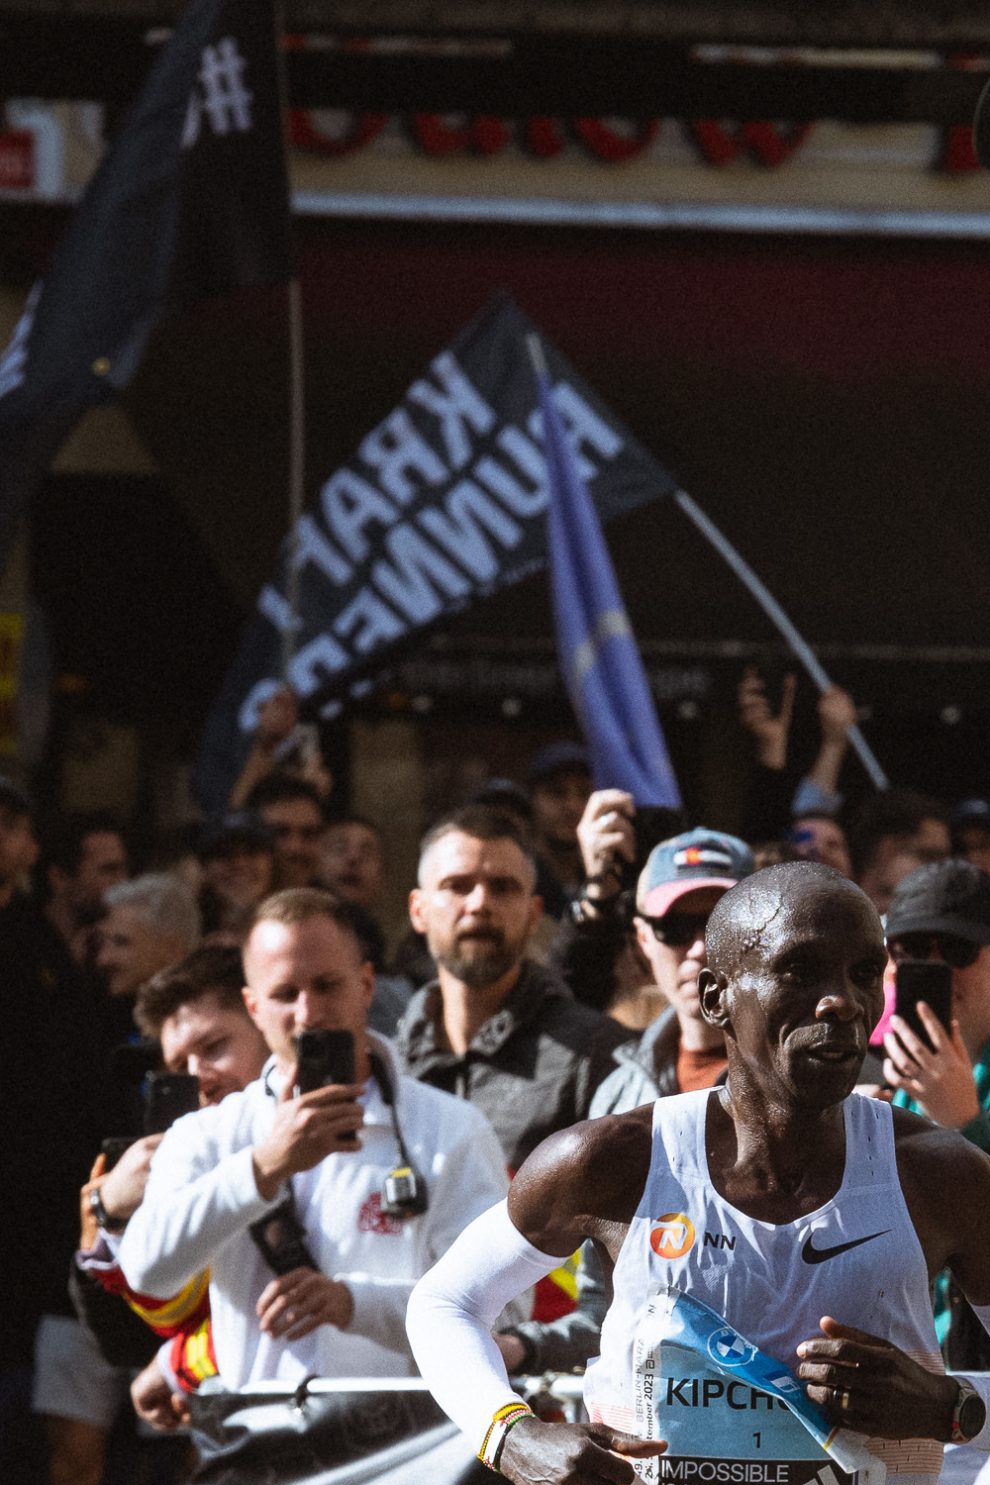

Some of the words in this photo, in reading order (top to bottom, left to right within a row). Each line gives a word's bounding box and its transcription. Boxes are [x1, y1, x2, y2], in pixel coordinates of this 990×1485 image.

[703, 1231, 737, 1251] NN
[643, 1373, 654, 1401] 2023
[752, 1431, 761, 1449] 1
[661, 1460, 789, 1483] IMPOSSIBLE
